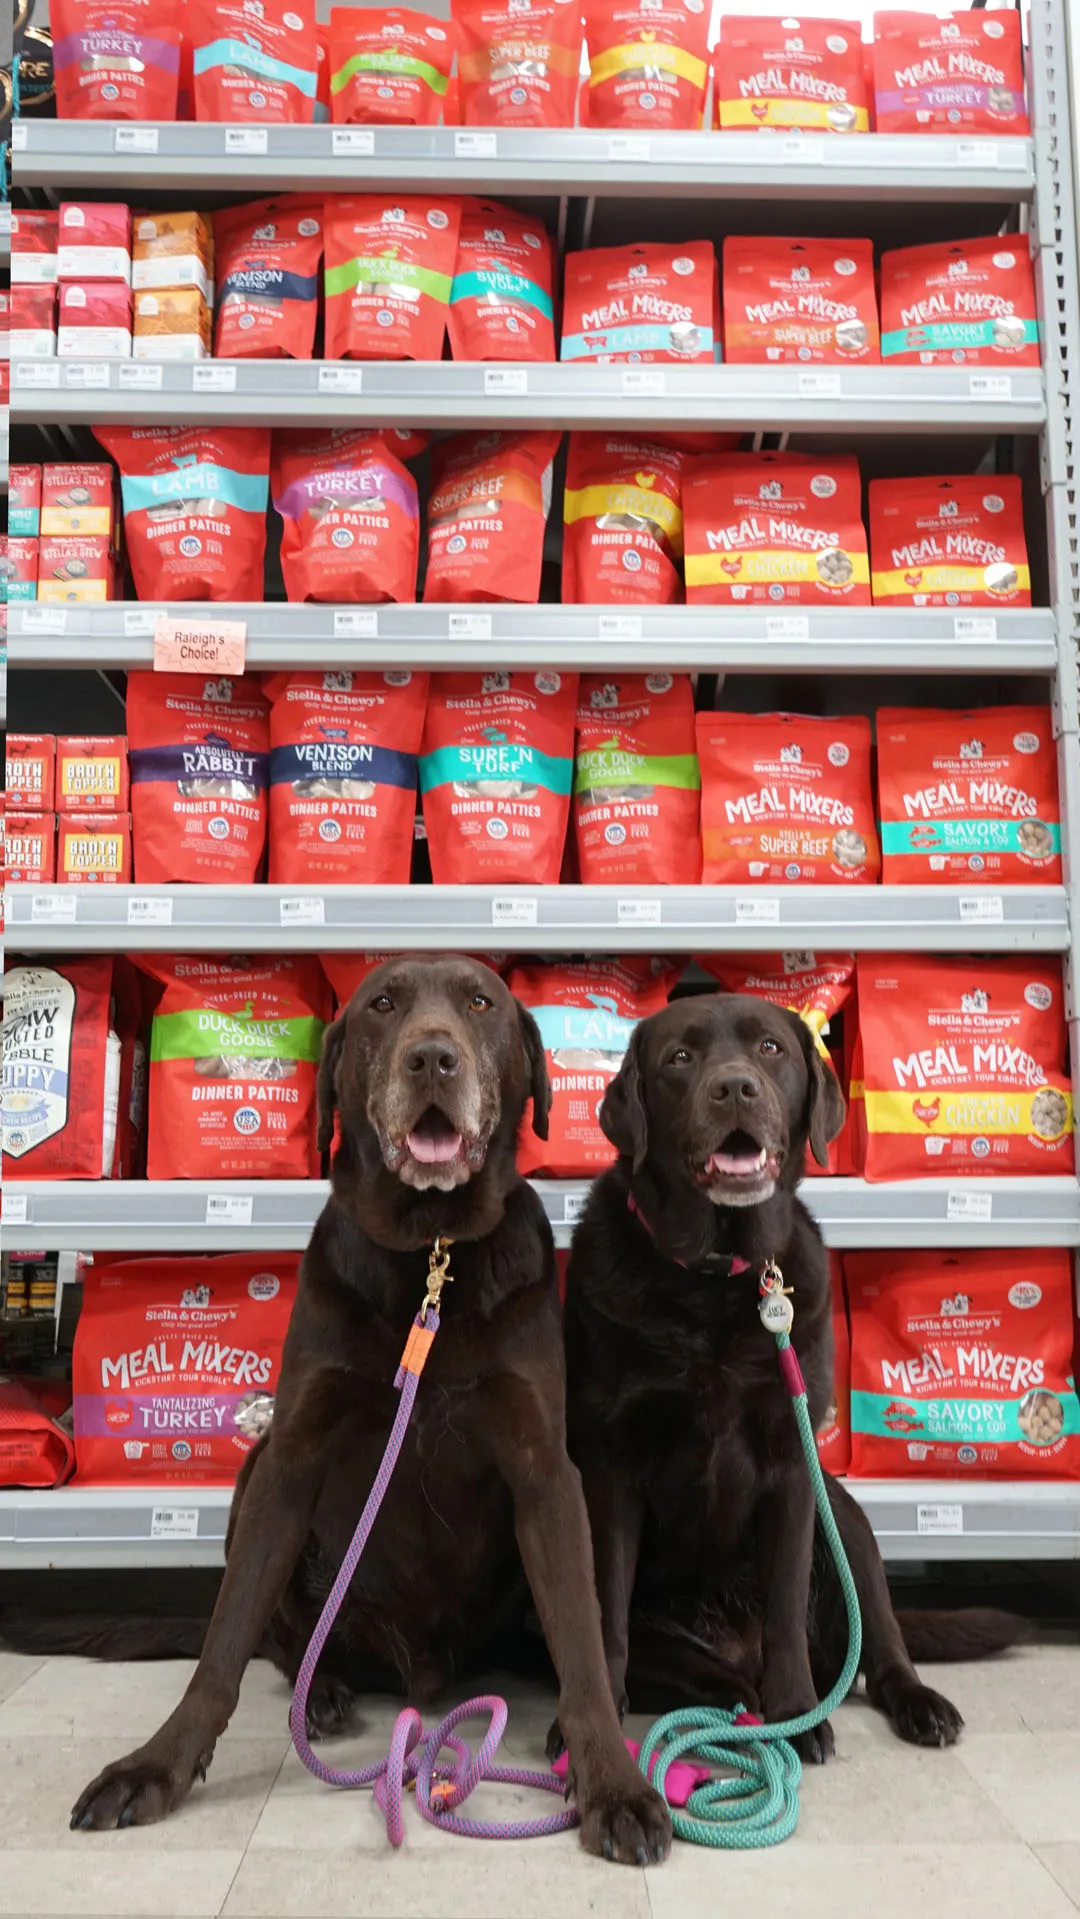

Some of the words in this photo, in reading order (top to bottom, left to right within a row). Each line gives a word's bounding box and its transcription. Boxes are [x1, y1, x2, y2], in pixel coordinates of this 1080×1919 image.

[80, 38, 142, 54] TURKEY
[894, 56, 947, 88] MEAL
[949, 53, 1006, 86] MIXERS
[738, 69, 787, 97] MEAL
[791, 70, 848, 102] MIXERS
[581, 297, 630, 331] MEAL
[631, 293, 694, 324] MIXERS
[744, 294, 795, 324] MEAL
[797, 292, 859, 323] MIXERS
[900, 292, 946, 326] MEAL
[954, 290, 1016, 320] MIXERS
[151, 470, 222, 496] LAMB
[303, 473, 386, 499] TURKEY
[470, 474, 504, 497] BEEF
[146, 520, 186, 540] DINNER
[190, 519, 232, 536] PATTIES
[343, 511, 390, 530] PATTIES
[458, 519, 503, 533] PATTIES
[590, 533, 633, 546] DINNER
[705, 516, 767, 552] MEAL
[769, 517, 840, 551] MIXERS
[891, 535, 942, 568] MEAL
[945, 533, 1006, 565] MIXERS
[747, 559, 809, 577] CHICKEN
[174, 631, 225, 647] Raleigh's
[180, 645, 219, 661] Choice!
[287, 690, 322, 702] Stella
[323, 692, 334, 703] &
[334, 693, 385, 708] Chewy's
[445, 697, 482, 710] Stella
[492, 694, 537, 711] Chewy's
[165, 697, 203, 711] Stella
[214, 704, 265, 720] Chewy's
[194, 745, 245, 760] ABSOLUTELY
[294, 744, 374, 763] VENISON
[458, 747, 510, 764] SURF
[6, 762, 42, 778] ROTH
[67, 762, 115, 778] BROTH
[182, 751, 258, 778] RABBIT
[311, 761, 353, 772] BLEND
[473, 760, 522, 774] TURF
[6, 776, 42, 788] PPER
[67, 777, 115, 791] TOPPER
[724, 786, 787, 824] MEAL
[789, 787, 854, 826] MIXERS
[902, 781, 967, 818] MEAL
[969, 780, 1038, 817] MIXERS
[173, 800, 217, 814] DINNER
[220, 800, 261, 822] PATTIES
[288, 802, 328, 817] DINNER
[331, 801, 378, 818] PATTIES
[451, 800, 494, 817] DINNER
[497, 801, 542, 818] PATTIES
[613, 802, 659, 819] PATTIES
[943, 822, 1010, 837] SAVORY
[5, 839, 42, 854] ROTH
[69, 839, 117, 855] BROTH
[760, 834, 798, 854] SUPER
[801, 838, 831, 856] BEEF
[5, 853, 42, 866] PPER
[69, 854, 117, 868] TOPPER
[174, 960, 218, 977] Stella
[199, 976, 219, 985] Only
[219, 975, 232, 984] the
[233, 974, 253, 985] good
[745, 974, 789, 992] Stella
[197, 1013, 244, 1034] DUCK
[245, 1022, 291, 1038] DUCK
[563, 1015, 631, 1041] LAM
[927, 1013, 963, 1027] Stella
[963, 1014, 973, 1026] &
[973, 1014, 1021, 1029] Chewy's
[219, 1033, 276, 1048] GOOSE
[891, 1044, 969, 1088] MEAL
[973, 1043, 1049, 1087] MIXERS
[3, 1063, 56, 1091] UPPY
[552, 1074, 605, 1092] DINNER
[974, 1073, 995, 1082] YOUR
[191, 1084, 243, 1102] DINNER
[247, 1085, 299, 1104] PATTIES
[235, 1115, 259, 1126] USA
[945, 1103, 1020, 1127] CHICKEN
[145, 1309, 179, 1322] Stella
[180, 1310, 189, 1321] &
[190, 1309, 238, 1324] Chewy's
[907, 1318, 941, 1332] Stella
[941, 1318, 952, 1330] &
[952, 1315, 1002, 1331] Chewy's
[100, 1340, 175, 1390] MEAL
[179, 1340, 274, 1386] MIXERS
[880, 1347, 955, 1395] MEAL
[956, 1346, 1046, 1393] MIXERS
[135, 1373, 176, 1388] KICKSTART
[178, 1373, 199, 1382] YOUR
[916, 1379, 958, 1395] KICKSTART
[959, 1378, 979, 1387] YOUR
[152, 1396, 216, 1410] TANTALIZING
[926, 1401, 1007, 1421] SAVORY
[139, 1406, 228, 1430] TURKEY
[926, 1421, 974, 1434] SALMON
[986, 1420, 1008, 1433] COD
